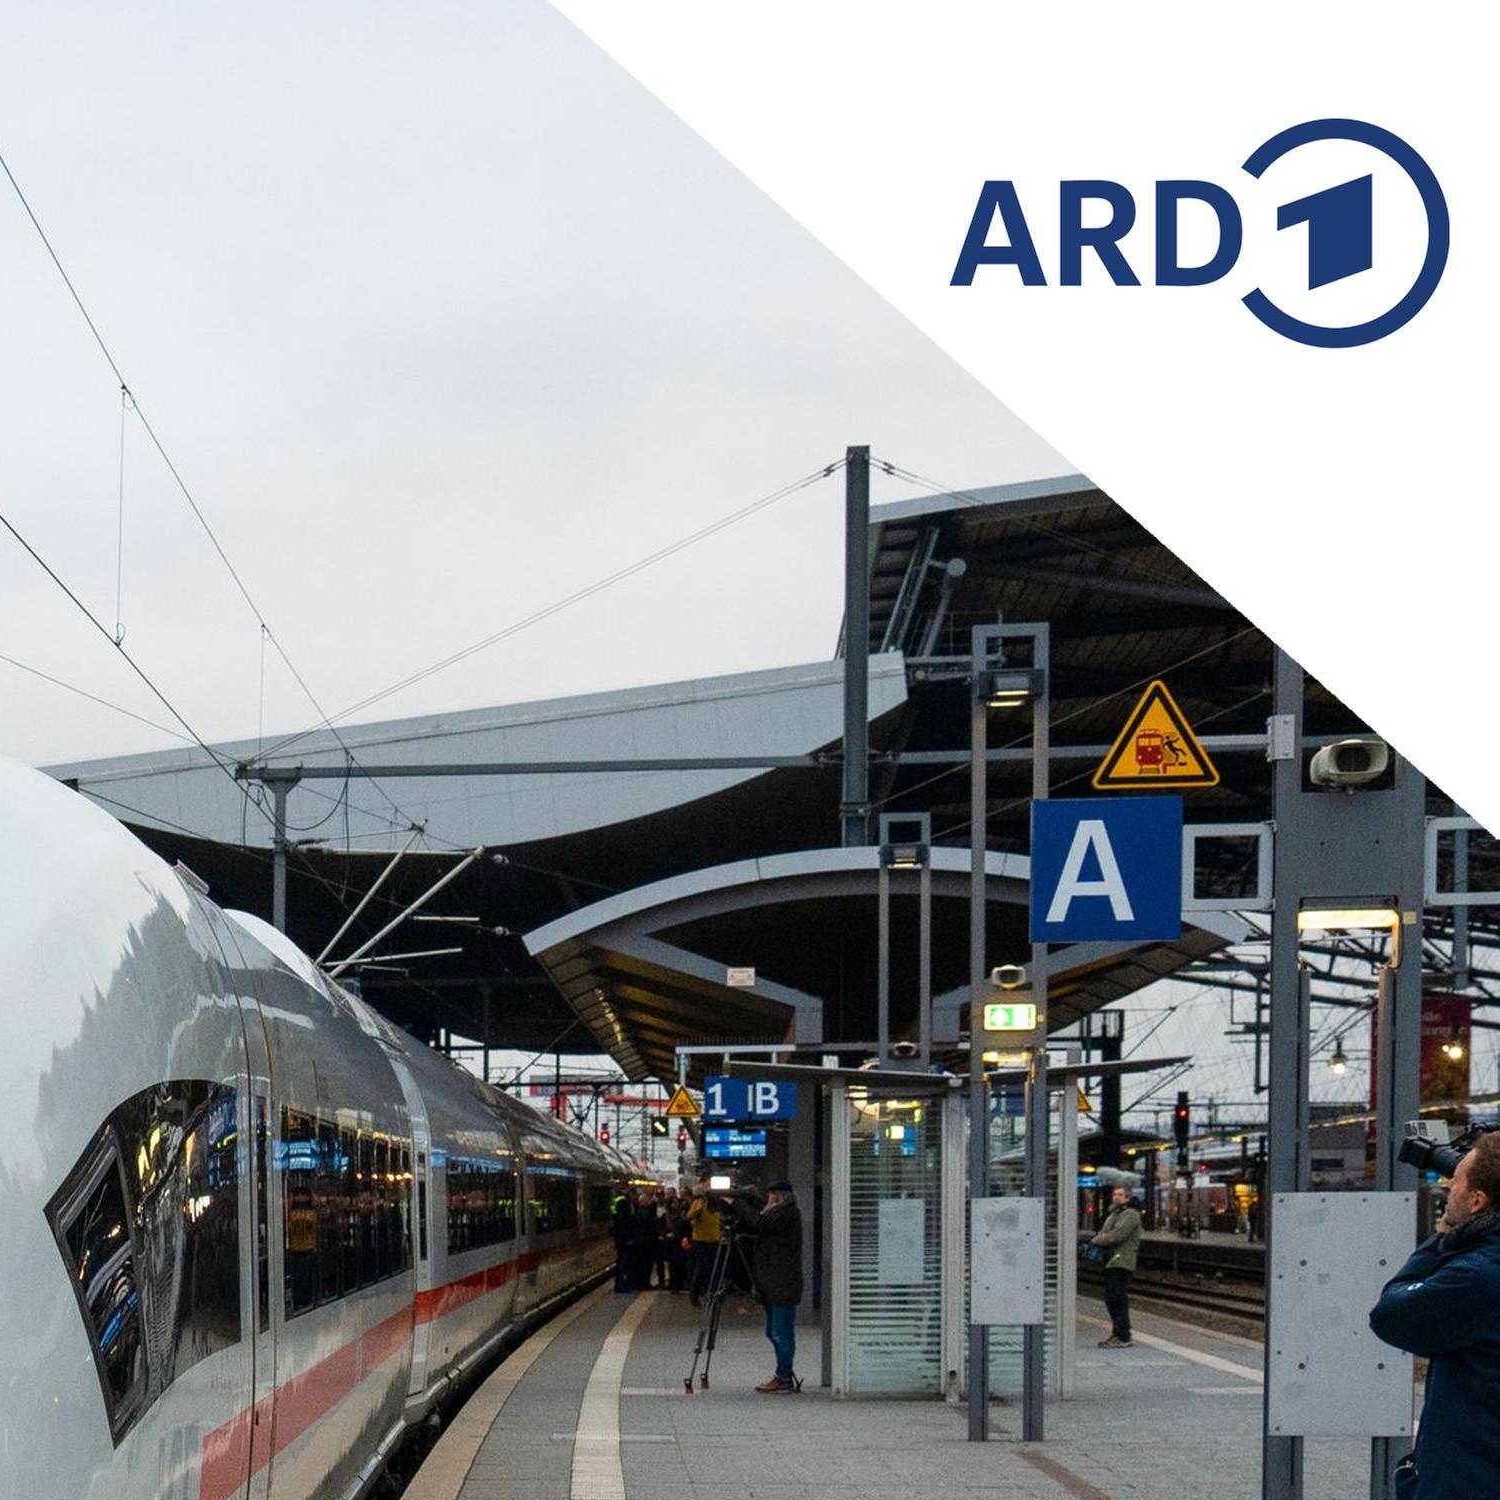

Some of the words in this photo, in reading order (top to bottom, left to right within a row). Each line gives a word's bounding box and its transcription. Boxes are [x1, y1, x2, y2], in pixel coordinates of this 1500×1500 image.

[1045, 819, 1135, 922] A
[707, 1082, 727, 1115] 1
[755, 1081, 780, 1115] B
